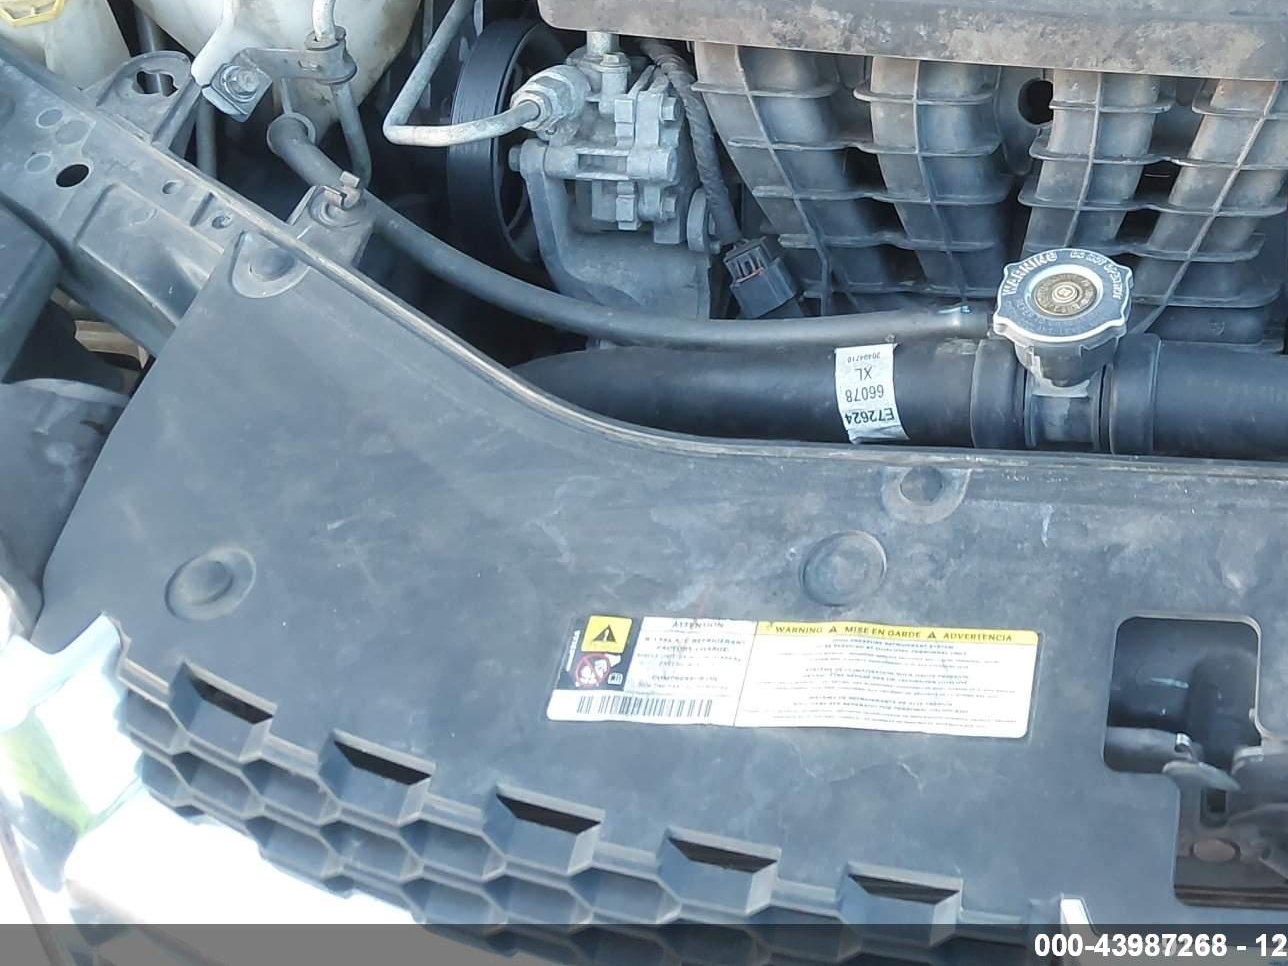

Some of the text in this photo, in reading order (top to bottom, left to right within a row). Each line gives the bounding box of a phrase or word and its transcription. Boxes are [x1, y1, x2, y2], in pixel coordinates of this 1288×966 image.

[1002, 251, 1058, 296] WARNING
[855, 366, 873, 381] XL
[845, 384, 884, 403] 66078
[845, 407, 895, 425] E72624
[775, 625, 1013, 643] WARNING MISE EN GARDE ADVERTENCIA
